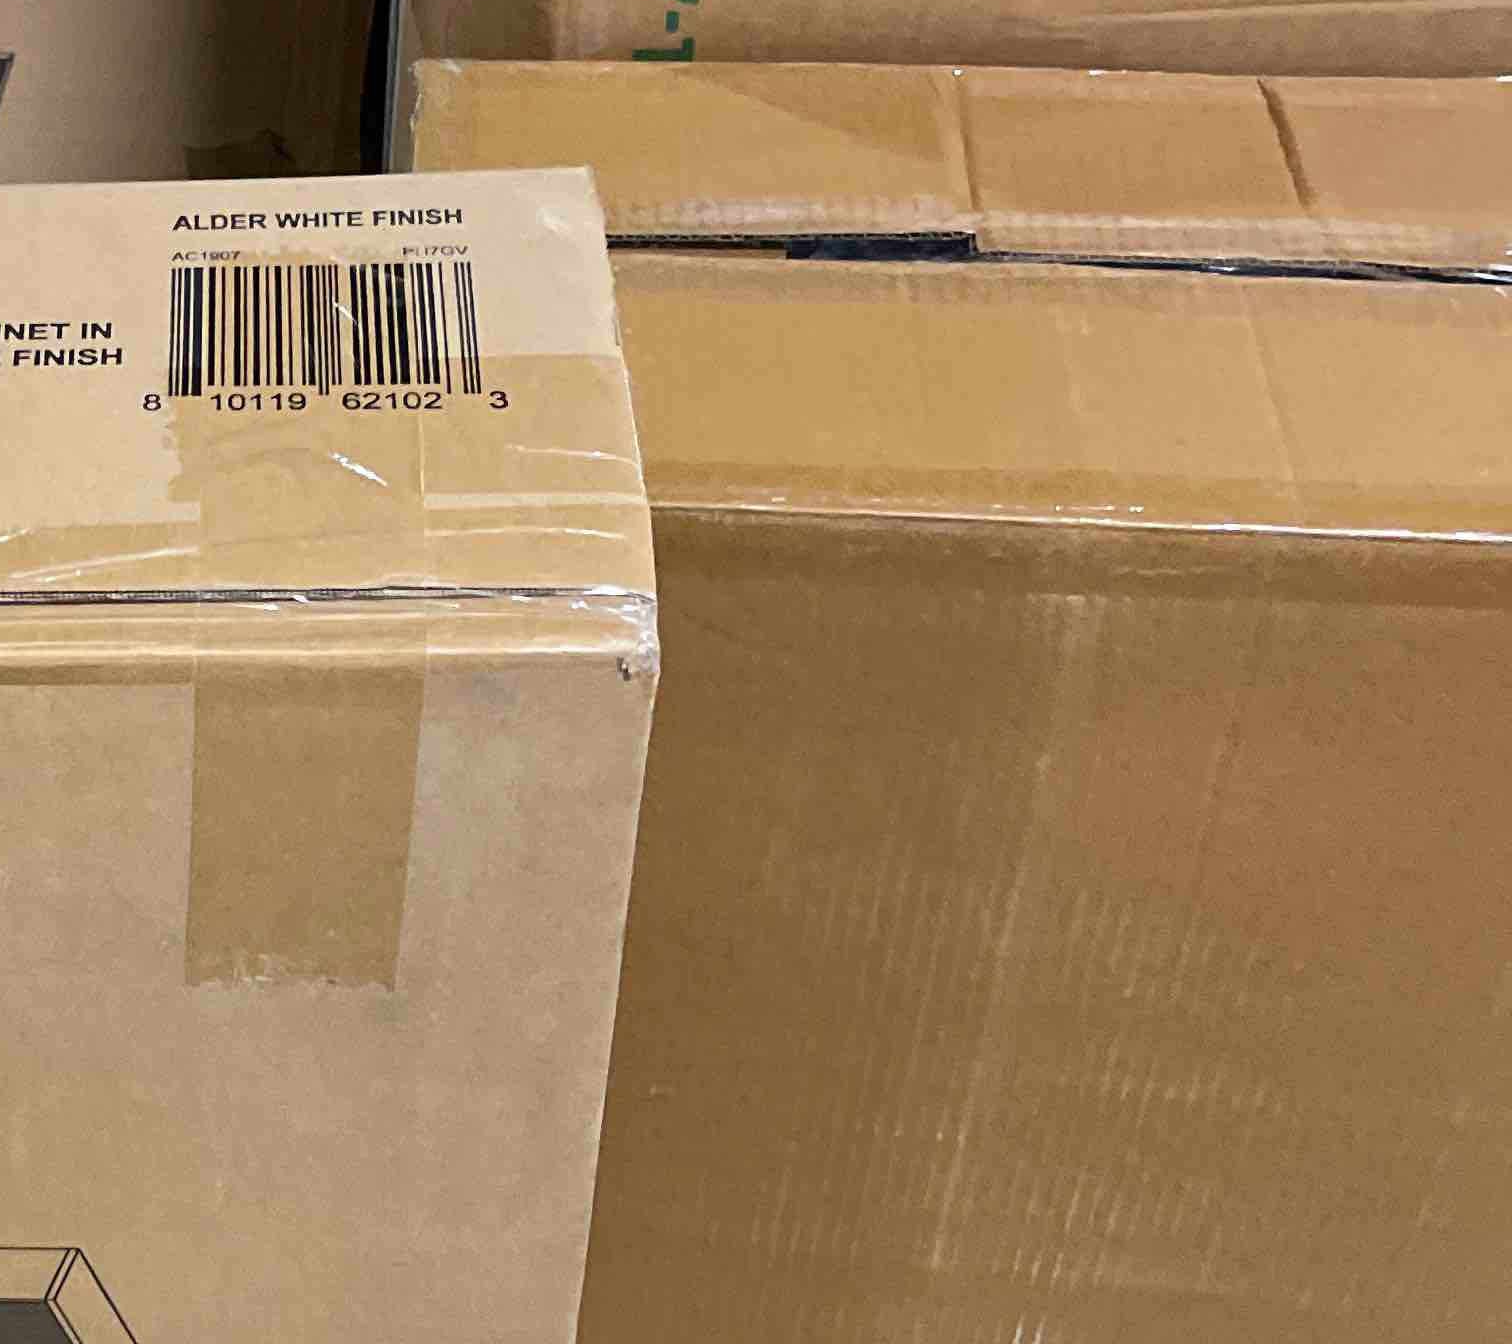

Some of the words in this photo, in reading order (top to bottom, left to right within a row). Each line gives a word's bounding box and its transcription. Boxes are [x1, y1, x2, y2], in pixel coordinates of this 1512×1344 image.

[172, 212, 268, 232] ALDER
[274, 210, 365, 230] WHITE
[372, 208, 464, 227] FINISH
[170, 250, 242, 263] AC1907
[79, 321, 115, 340] IN
[11, 348, 125, 367] FINISH
[142, 392, 163, 412] 8
[209, 392, 309, 411] 10119
[341, 391, 444, 411] 62102
[488, 390, 510, 410] 3
